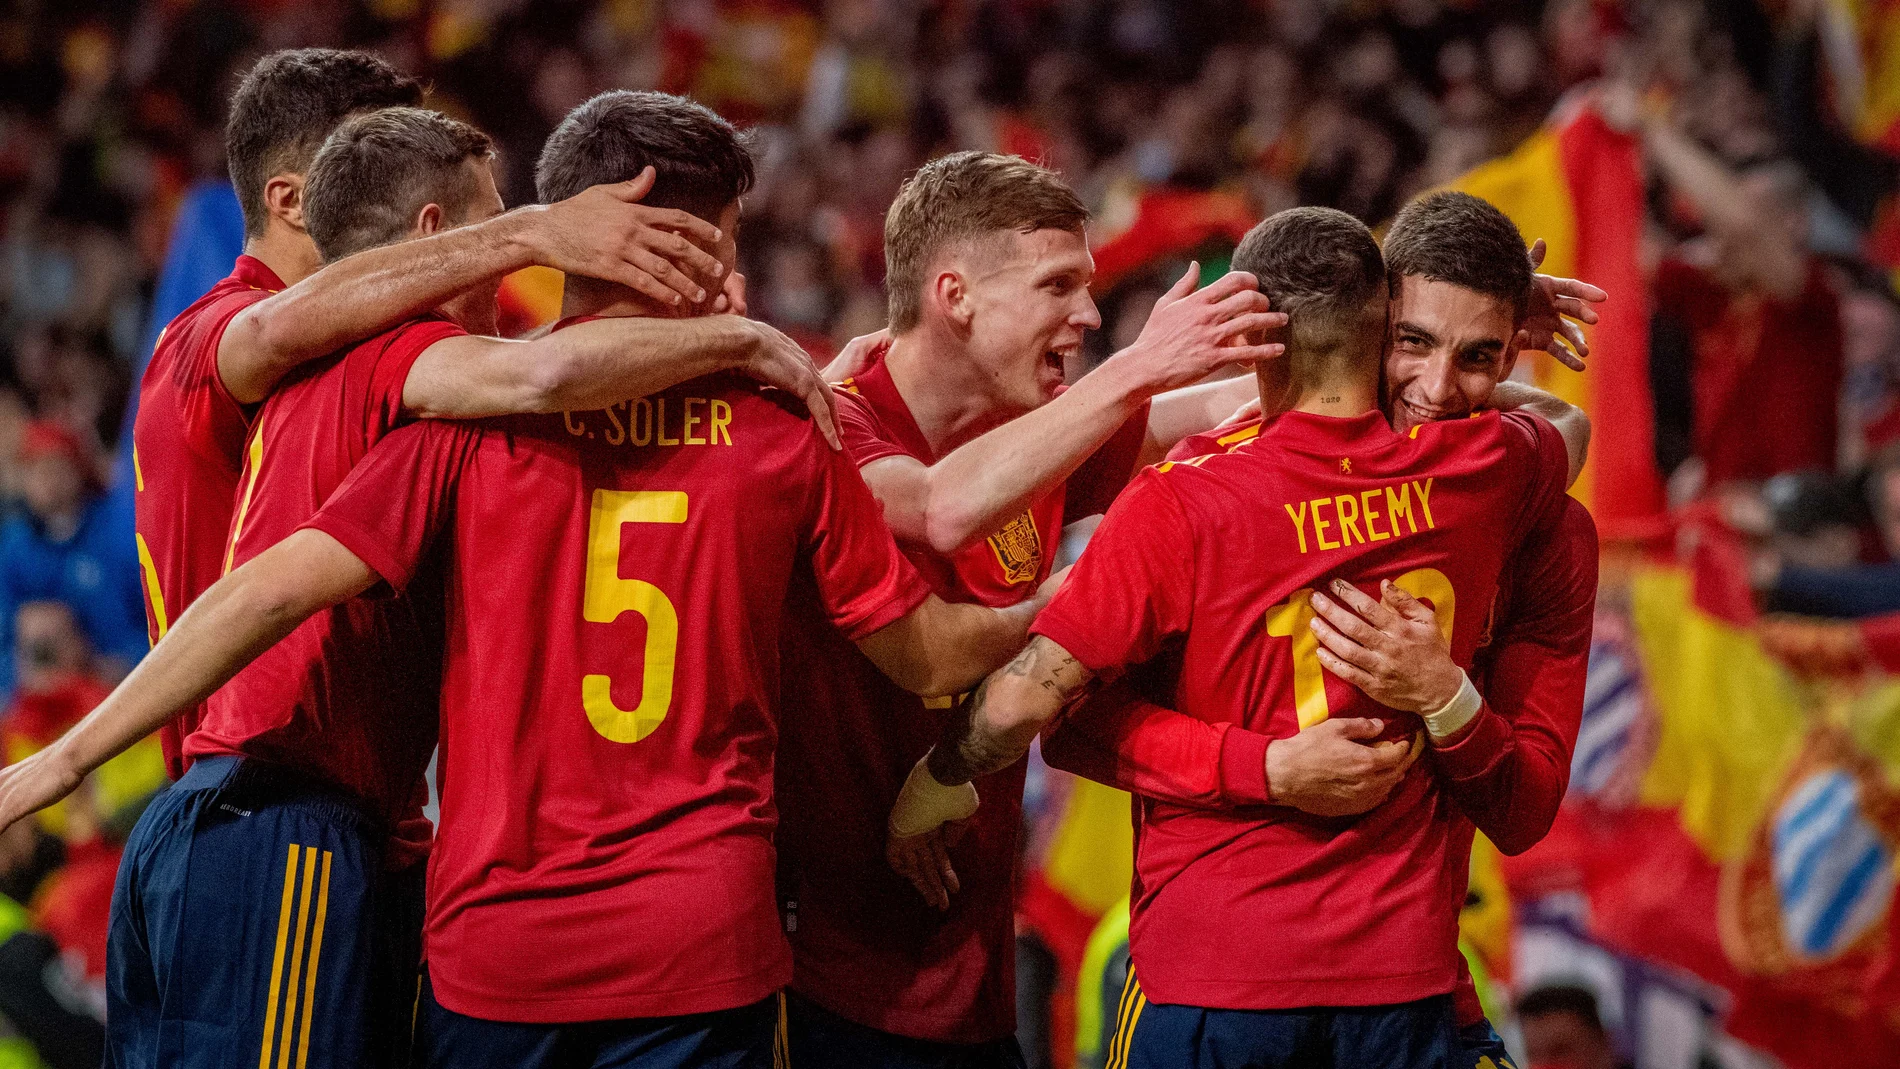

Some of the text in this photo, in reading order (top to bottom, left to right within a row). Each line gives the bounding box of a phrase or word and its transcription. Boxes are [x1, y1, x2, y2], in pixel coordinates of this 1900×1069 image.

[604, 398, 733, 447] SOLER
[1284, 477, 1435, 554] YEREMY
[582, 488, 689, 744] 5
